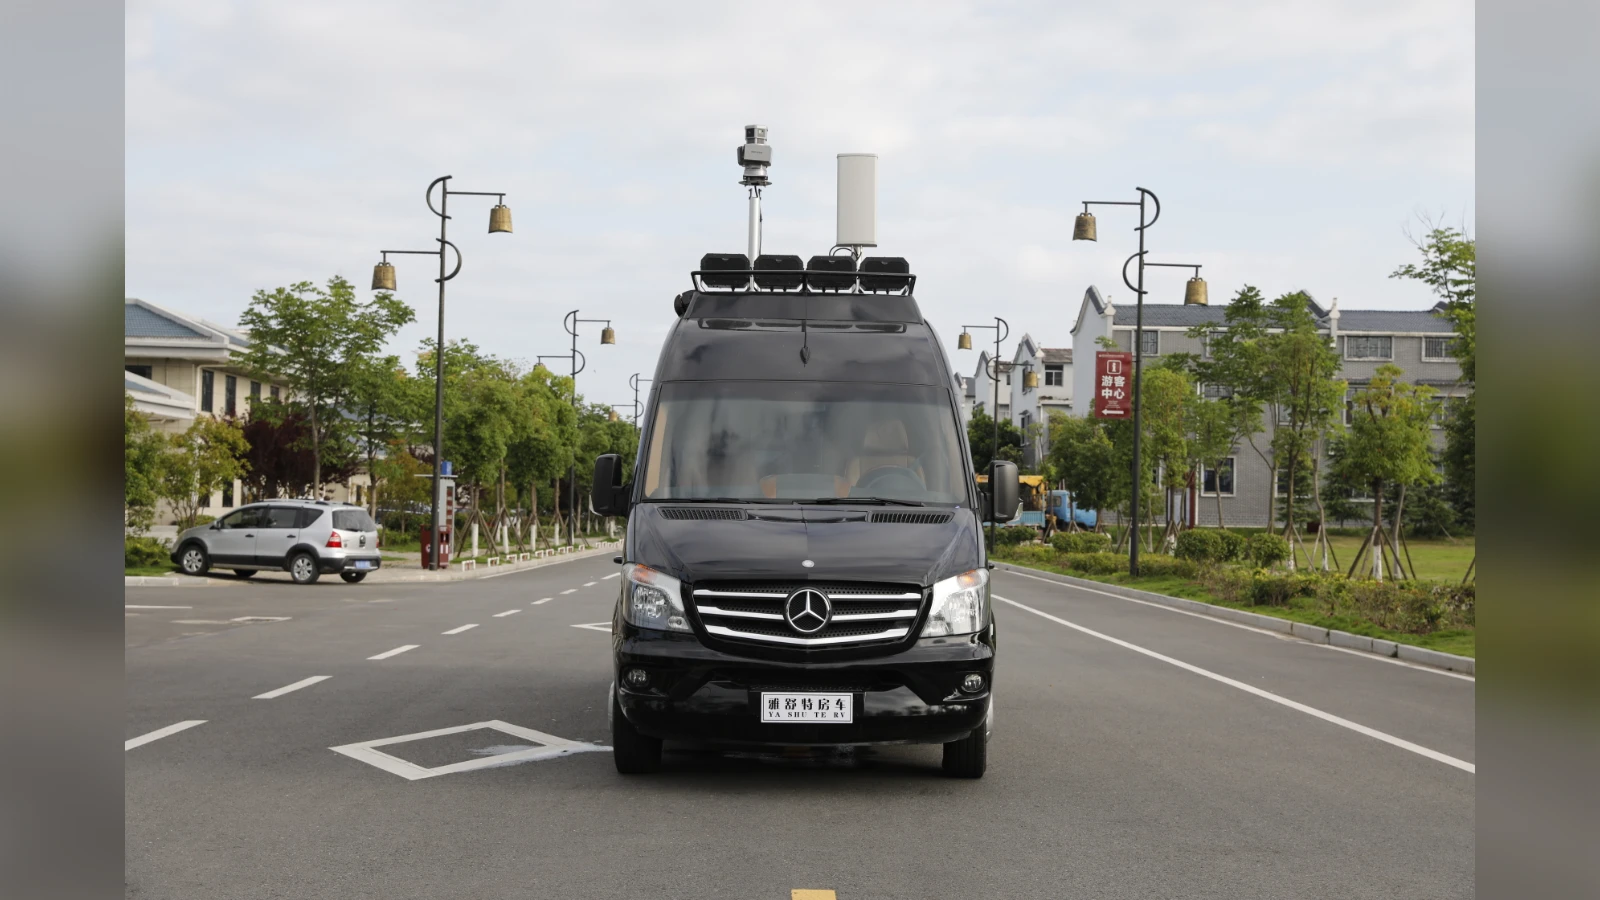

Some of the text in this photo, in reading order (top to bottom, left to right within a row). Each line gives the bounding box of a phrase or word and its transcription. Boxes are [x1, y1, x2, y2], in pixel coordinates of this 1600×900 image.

[1101, 375, 1125, 387] 游客
[1101, 388, 1125, 399] 中心
[768, 697, 846, 711] 雅舒特房车
